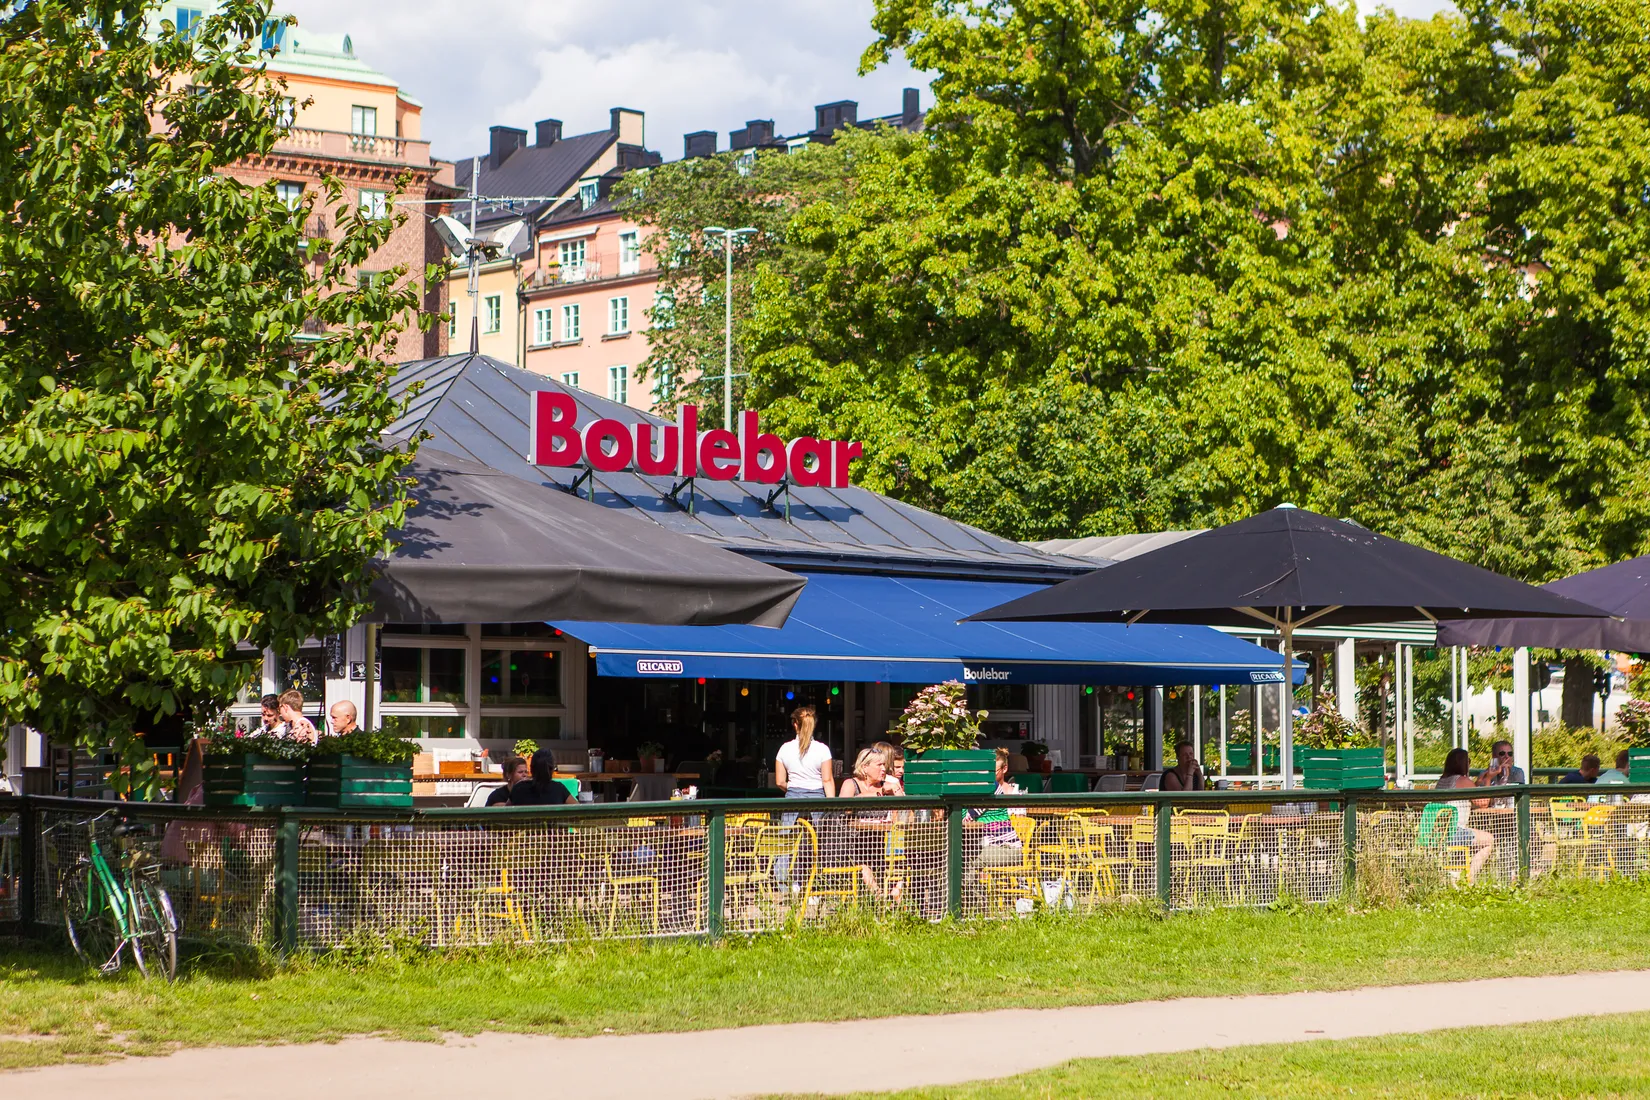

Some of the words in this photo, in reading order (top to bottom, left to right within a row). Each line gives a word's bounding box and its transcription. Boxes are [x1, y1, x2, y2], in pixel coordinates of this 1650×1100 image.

[530, 390, 863, 488] Boulebar
[639, 662, 681, 672] RICARD
[963, 667, 1009, 680] Boulebar
